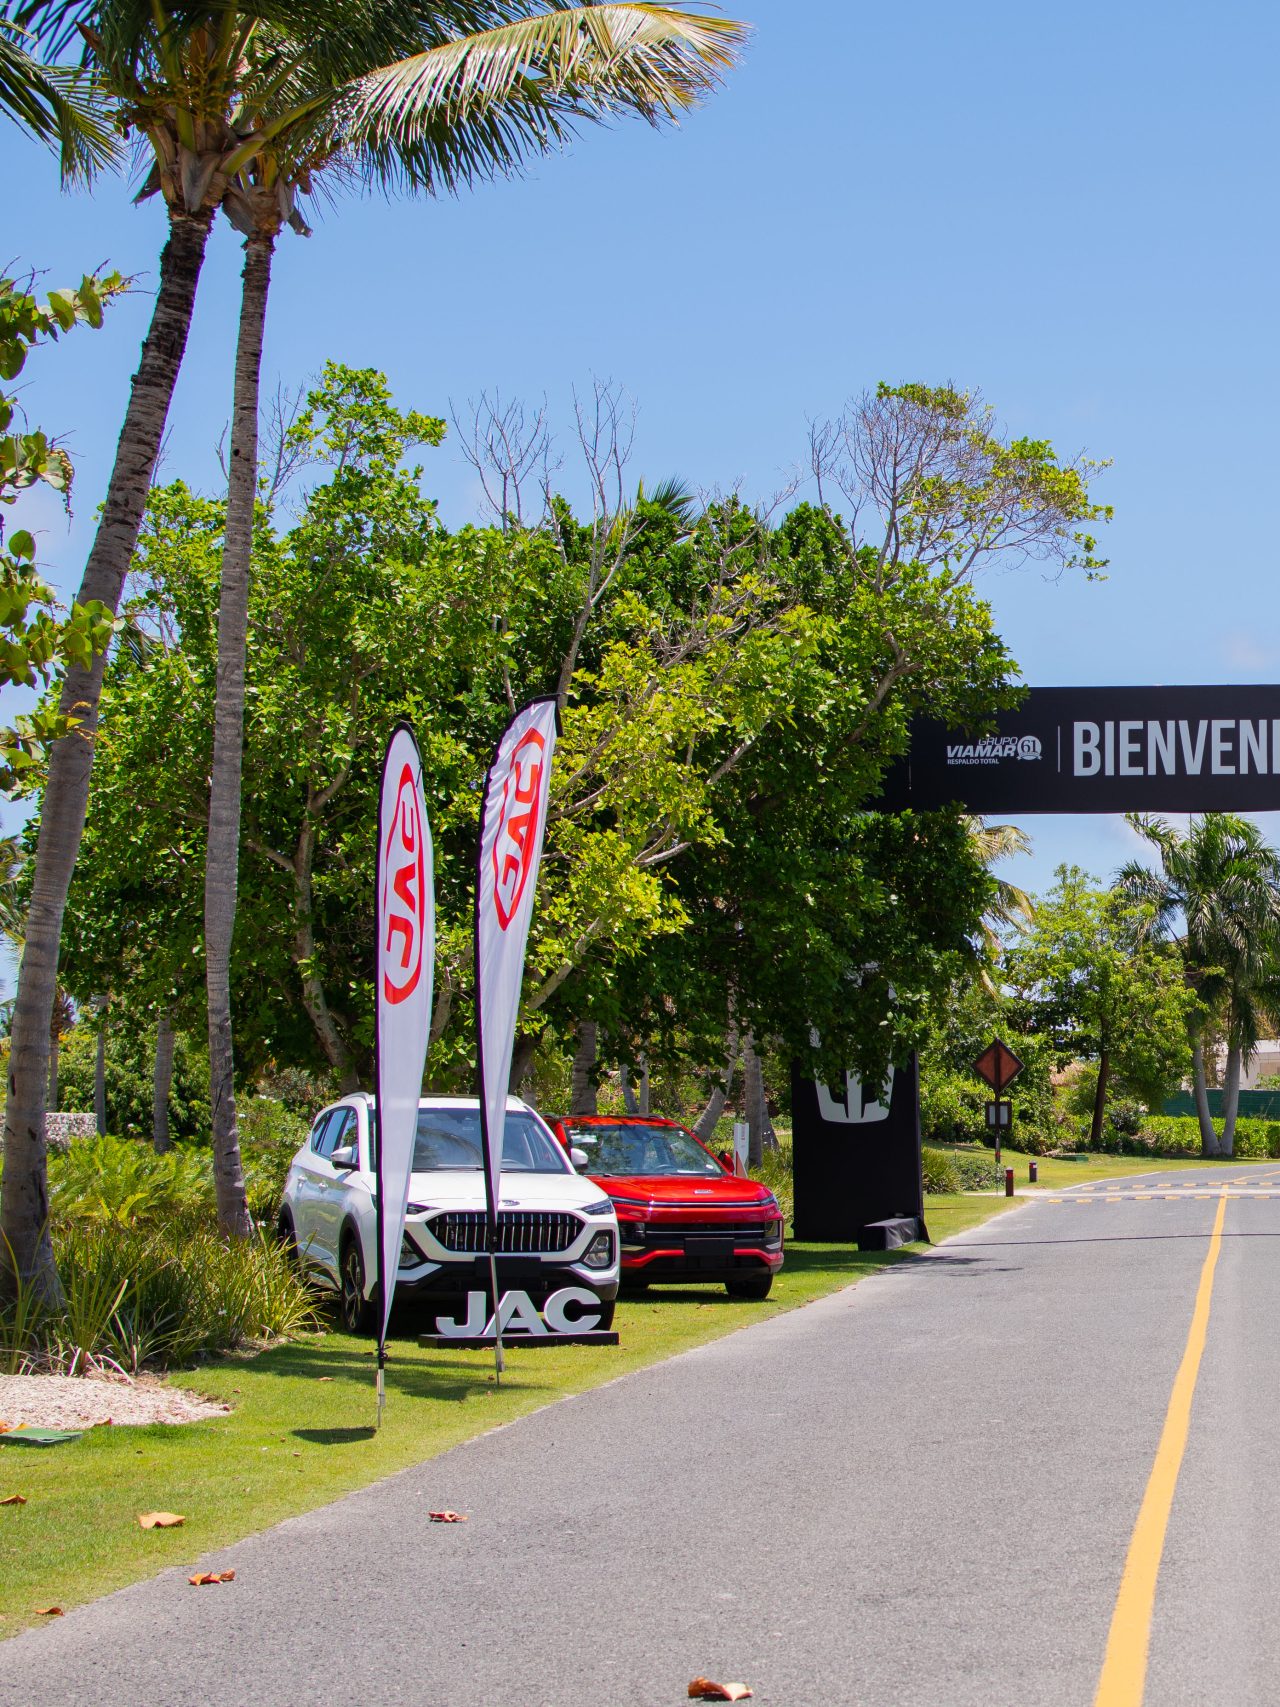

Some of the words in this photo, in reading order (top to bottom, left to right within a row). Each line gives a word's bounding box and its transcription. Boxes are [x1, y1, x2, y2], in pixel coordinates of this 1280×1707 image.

[978, 736, 1018, 746] GRUPO
[1021, 739, 1037, 753] 61
[946, 745, 1016, 758] VIAMAR
[386, 800, 416, 969] JAC
[435, 1286, 602, 1337] JAC
